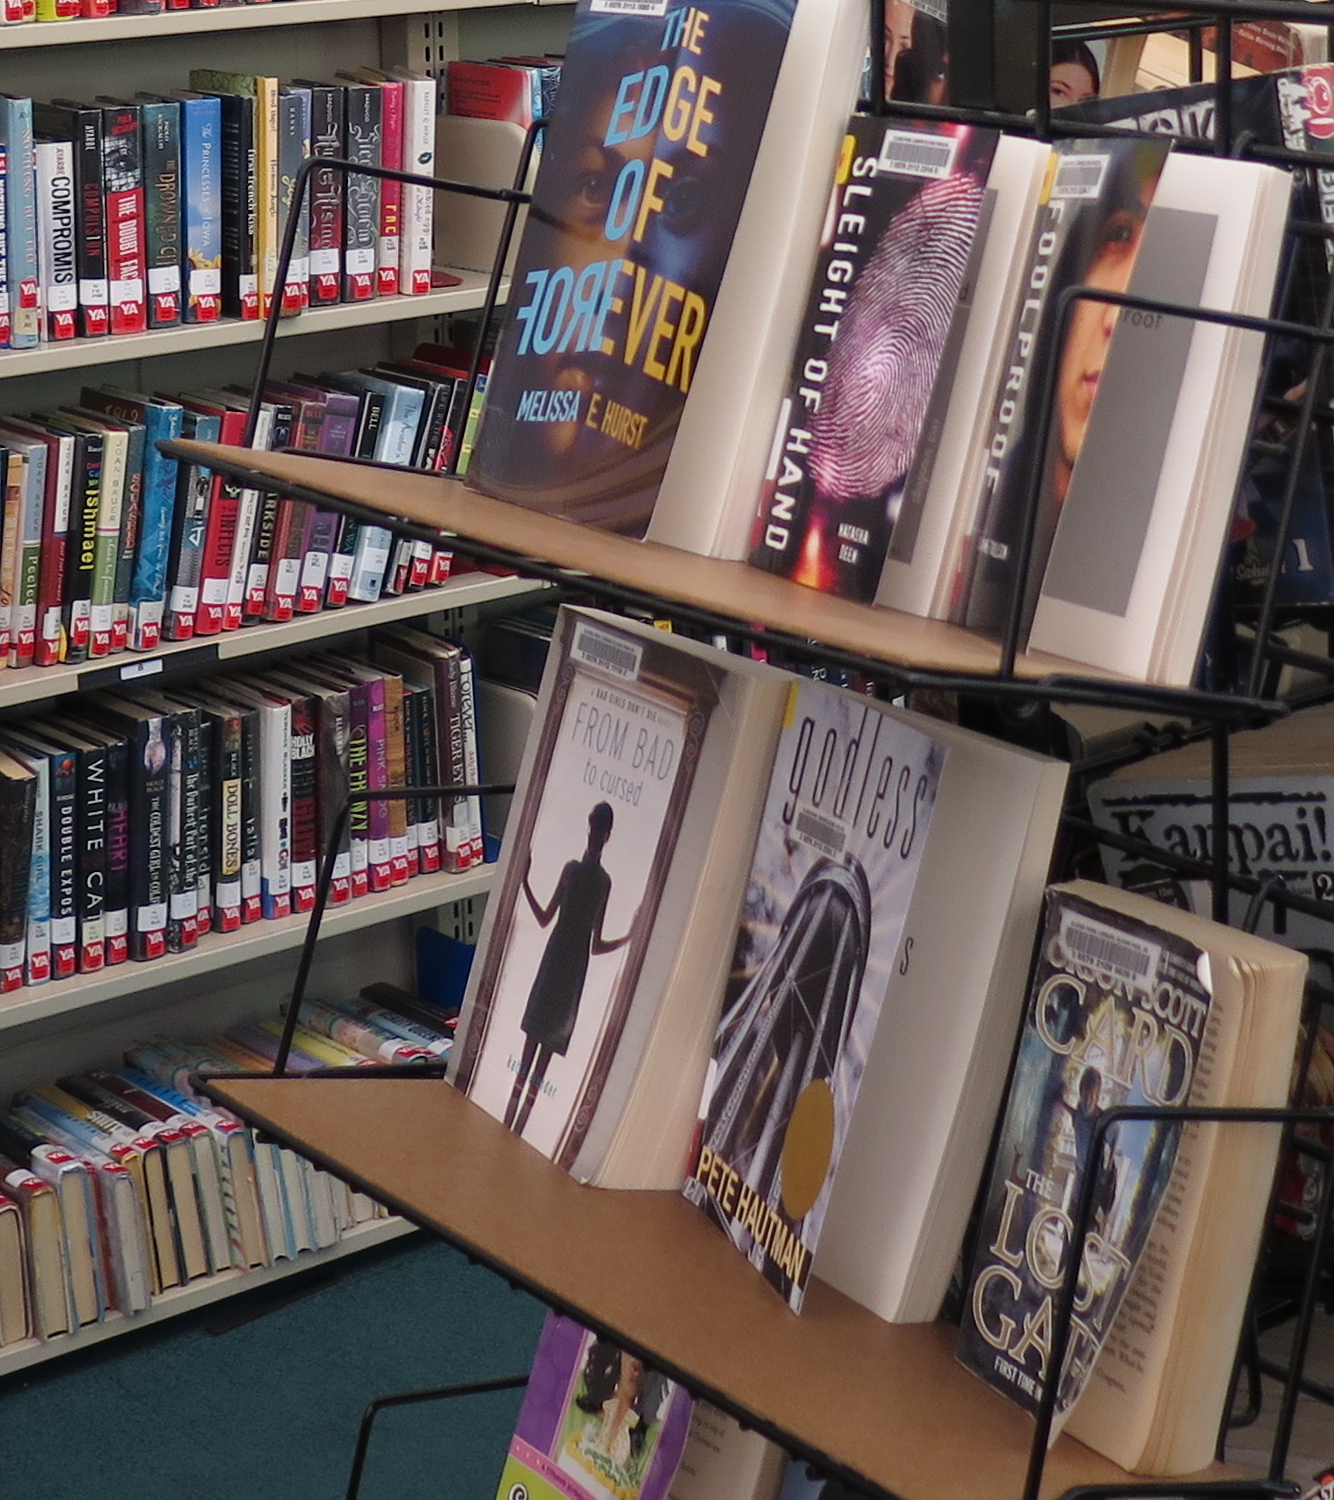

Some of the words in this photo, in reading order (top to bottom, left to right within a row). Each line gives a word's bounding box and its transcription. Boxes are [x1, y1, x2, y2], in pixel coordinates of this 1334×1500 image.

[660, 6, 709, 55] THE
[603, 64, 723, 158] EDGE
[604, 159, 674, 243] OF
[812, 155, 878, 341] SLEIGHT
[516, 259, 708, 393] FOREVER
[516, 390, 579, 423] MELISSA
[602, 404, 648, 450] HURST
[798, 357, 830, 414] OF
[764, 426, 812, 552] HAND
[837, 523, 870, 547] NATASHA
[838, 544, 859, 564] DEEN
[571, 702, 627, 759] FROM
[632, 729, 675, 781] BAD
[582, 759, 600, 784] to
[599, 768, 642, 808] cursed
[783, 704, 929, 860] godless
[86, 759, 105, 850] WHITE
[1035, 973, 1195, 1107] CARD
[696, 1146, 741, 1215] PETE
[734, 1183, 807, 1289] HAUTMAN
[1025, 1168, 1053, 1198] THE
[988, 1178, 1132, 1332] LOST
